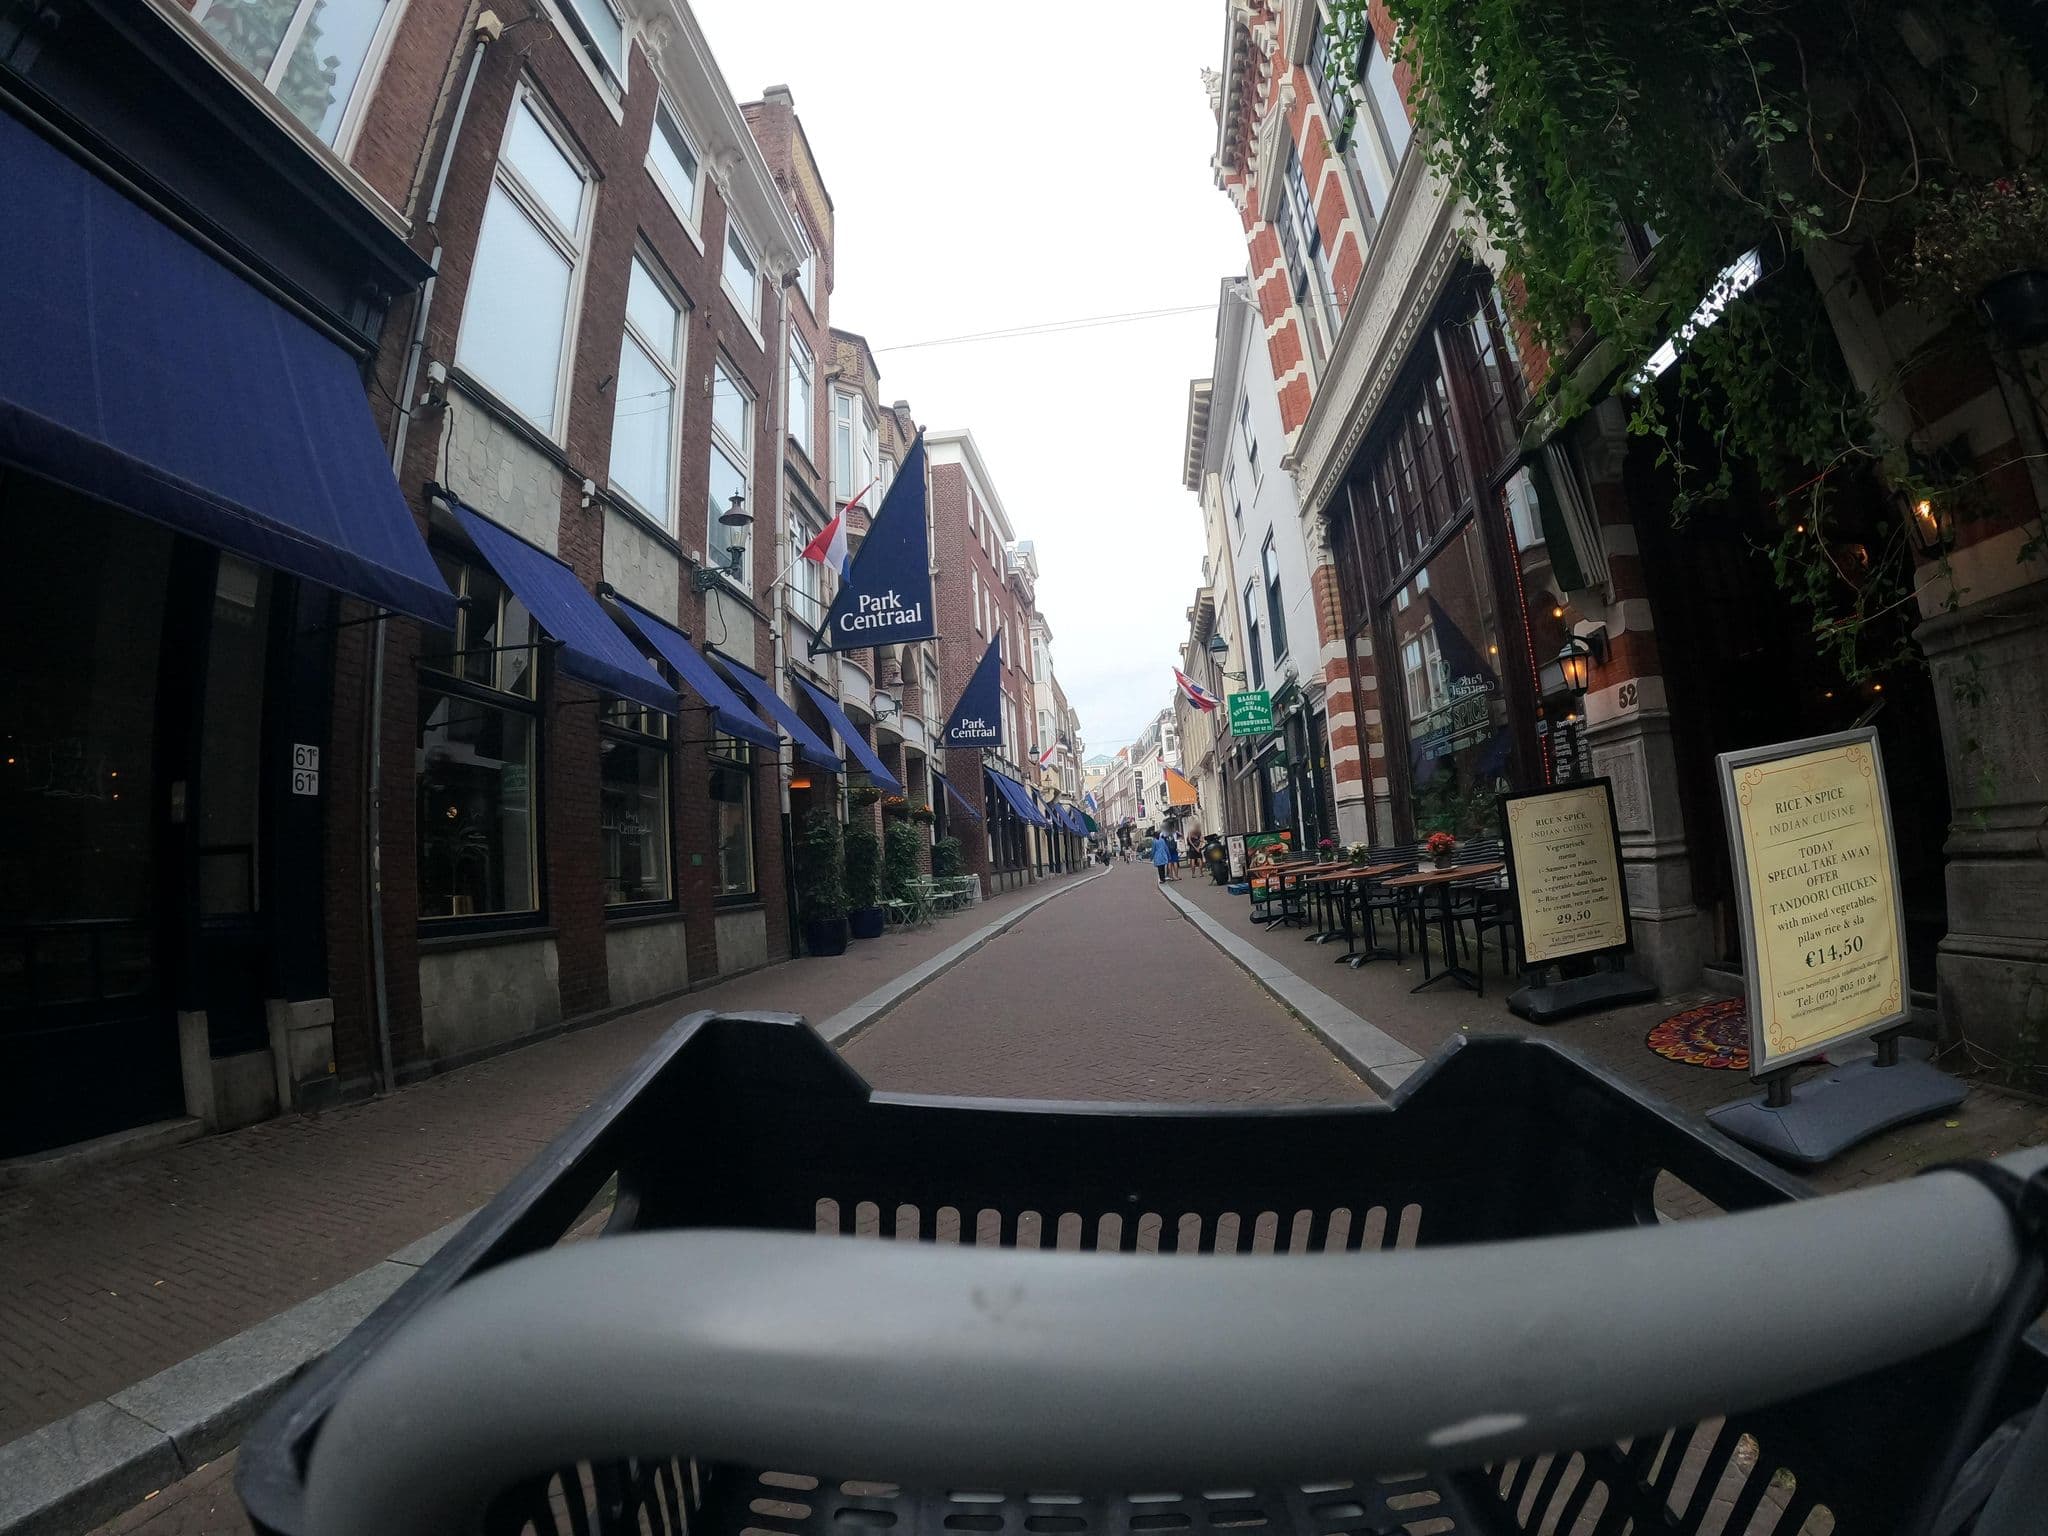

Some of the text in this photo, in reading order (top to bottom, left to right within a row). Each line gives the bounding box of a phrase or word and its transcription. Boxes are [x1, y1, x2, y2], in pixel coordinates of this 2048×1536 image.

[859, 590, 902, 613] Park
[840, 603, 922, 631] Centraal
[1619, 684, 1637, 709] 52
[962, 718, 985, 728] Park
[1248, 712, 1254, 720] &
[951, 726, 996, 738] Centraal
[1776, 798, 1802, 814] RICE
[1815, 787, 1845, 804] SPICE
[1531, 822, 1592, 838] INDIAN CUISINE
[1536, 818, 1553, 826] RICE
[1564, 812, 1586, 821] SPICE
[1769, 804, 1856, 835] INDIAN CUISINE
[1799, 840, 1834, 858] TODAY
[1768, 845, 1871, 883] SPECIAL TAKE AWAY
[1806, 870, 1839, 887] OFFER
[1770, 874, 1878, 915] TANDOORI CHICKEN
[1557, 909, 1591, 924] 29,50
[1778, 917, 1799, 931] with
[1802, 908, 1828, 925] mixed
[1798, 915, 1865, 947] pilaw rice & sla
[1806, 936, 1863, 967] €14,50
[1795, 996, 1814, 1008] Tel:
[1817, 987, 1838, 1003] (070)
